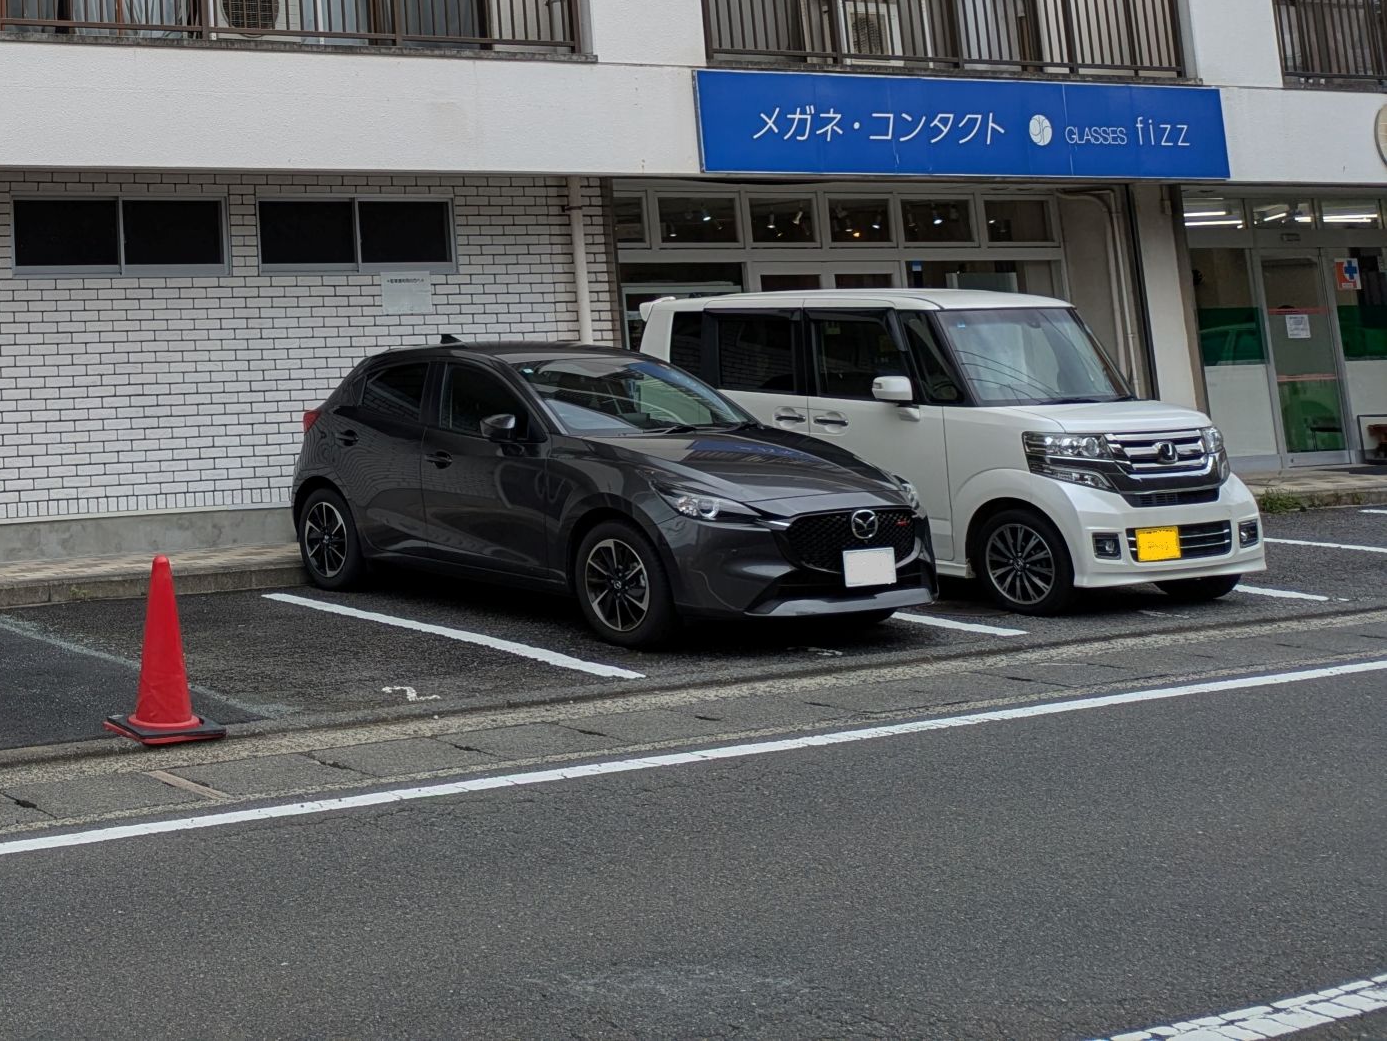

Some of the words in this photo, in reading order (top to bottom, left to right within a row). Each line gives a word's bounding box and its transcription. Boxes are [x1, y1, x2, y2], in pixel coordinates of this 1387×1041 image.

[752, 105, 1005, 145] メガネ・コンタクト
[1065, 126, 1128, 145] GLASSES
[1135, 116, 1191, 146] fizz
